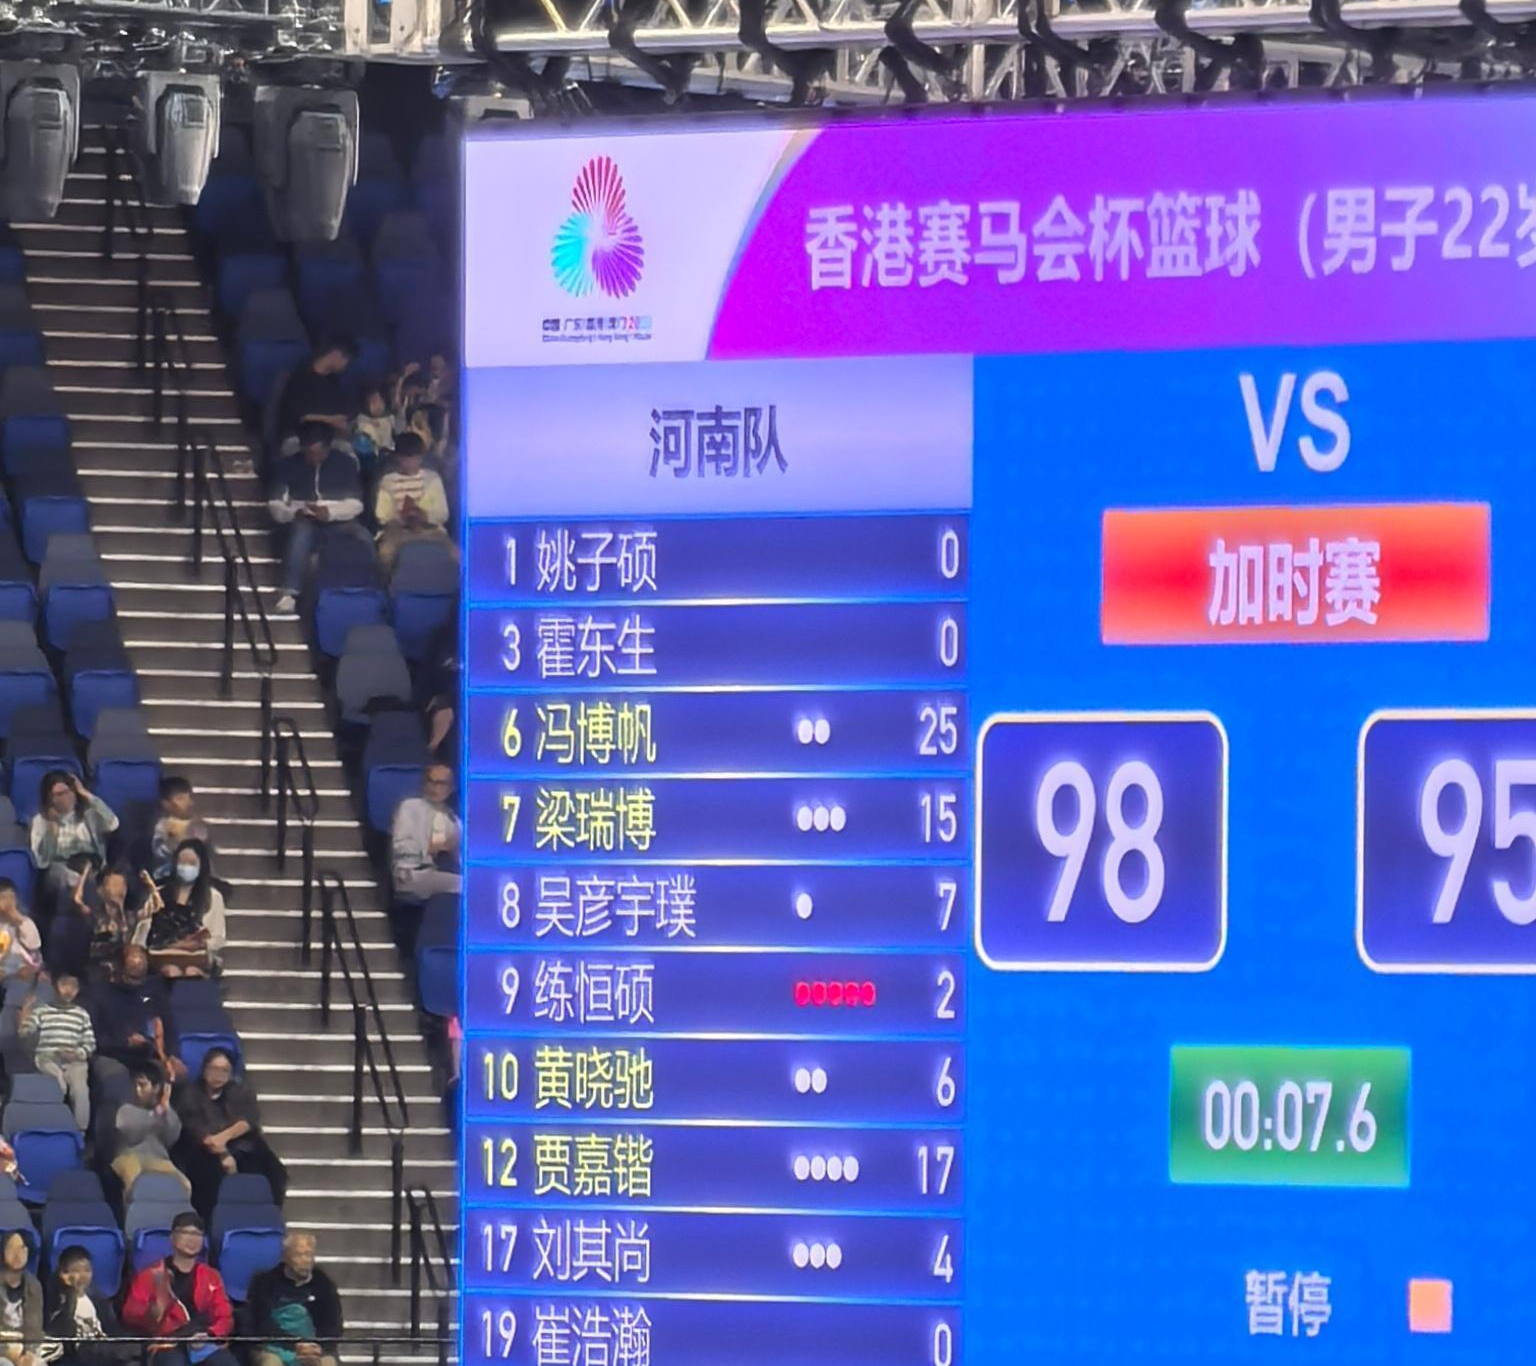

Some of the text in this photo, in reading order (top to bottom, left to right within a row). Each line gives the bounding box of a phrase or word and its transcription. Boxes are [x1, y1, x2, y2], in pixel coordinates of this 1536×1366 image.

[650, 405, 788, 477] 河南队
[1240, 371, 1350, 471] VS
[506, 529, 958, 592] 1 姚子硕 0
[1208, 536, 1380, 626] 加时赛
[503, 614, 958, 678] 3 霍东生 0
[504, 701, 957, 764] 6 冯博帆 25
[503, 787, 956, 850] 7 梁瑞博 15
[1036, 760, 1164, 922] 98
[502, 875, 956, 937] 8 吴彦宇璞 7
[502, 961, 954, 1023] 9 练恒硕 2
[485, 1045, 955, 1108] 10 黄晓驰 6
[1205, 1080, 1376, 1152] 00:07.6
[484, 1133, 954, 1196] 12 贾嘉锴 17
[484, 1219, 953, 1282] 17 刘其尚 4
[483, 1310, 516, 1357] 19
[1245, 1270, 1331, 1337] 暂停
